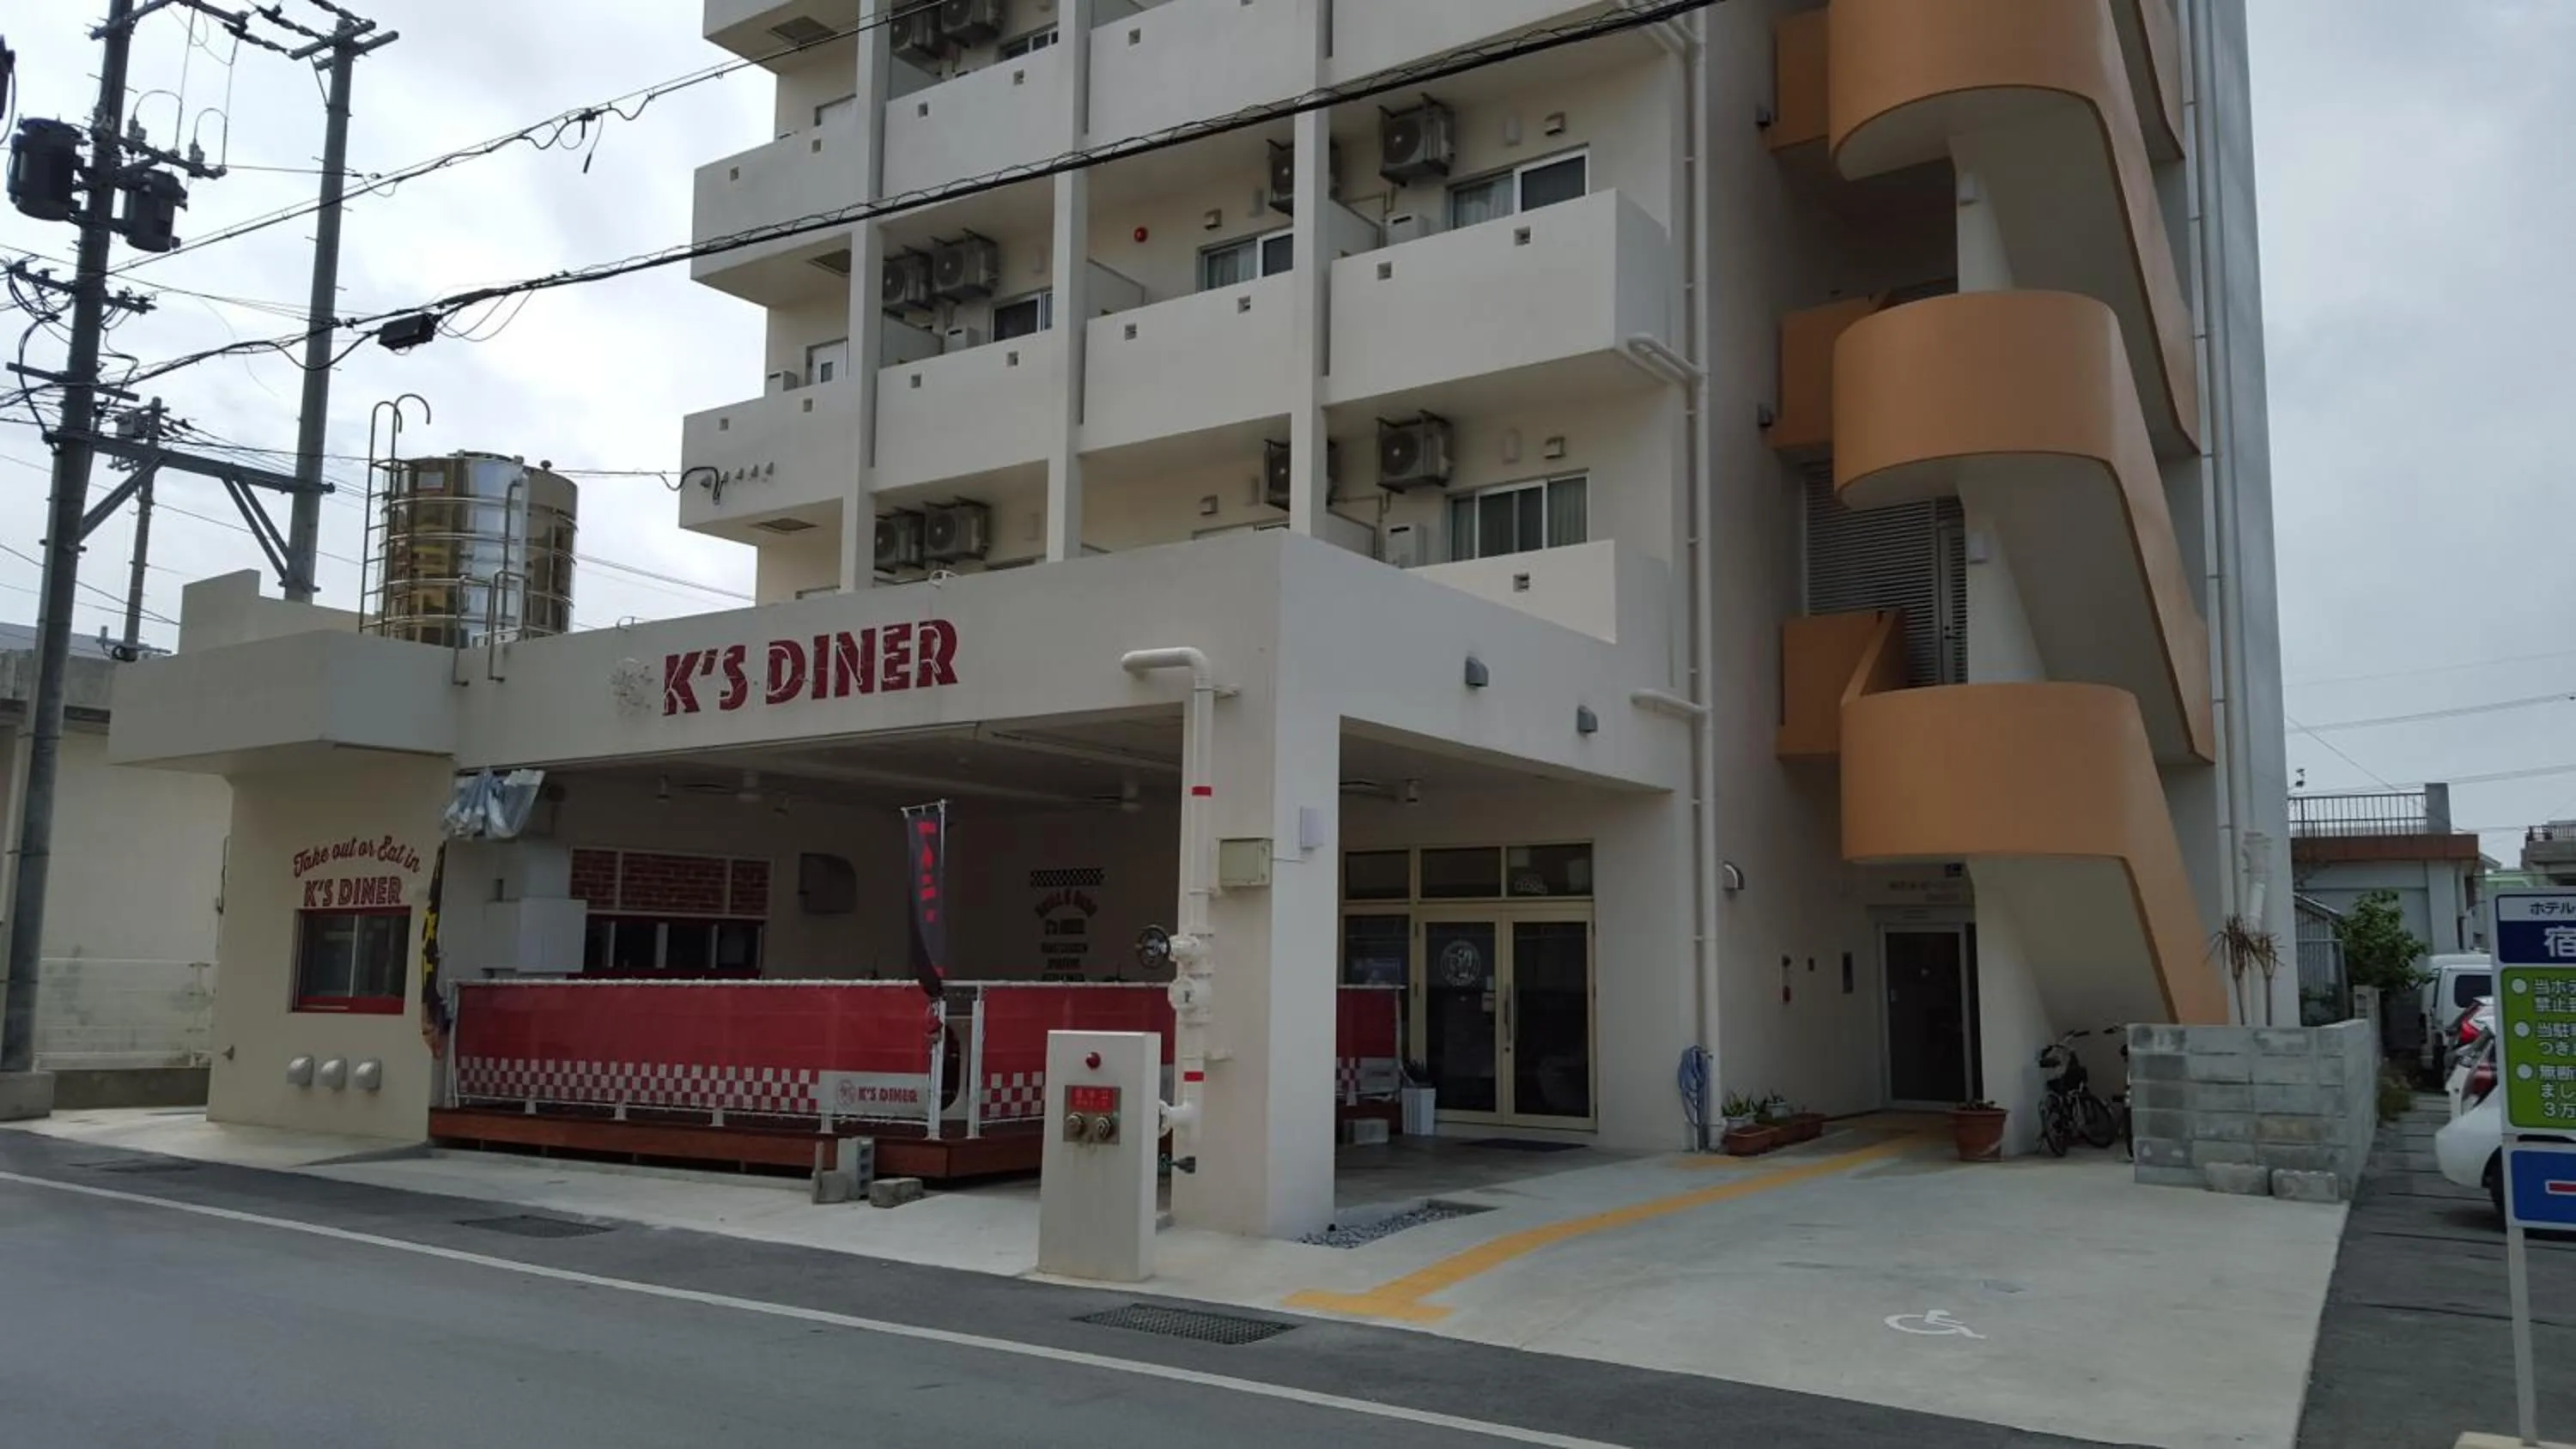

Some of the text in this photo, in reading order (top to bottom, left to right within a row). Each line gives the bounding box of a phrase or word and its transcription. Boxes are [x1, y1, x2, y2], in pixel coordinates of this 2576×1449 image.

[662, 619, 958, 716] K'S DINER
[294, 834, 421, 878] Take out or Eat in
[304, 876, 403, 907] K'S DINER
